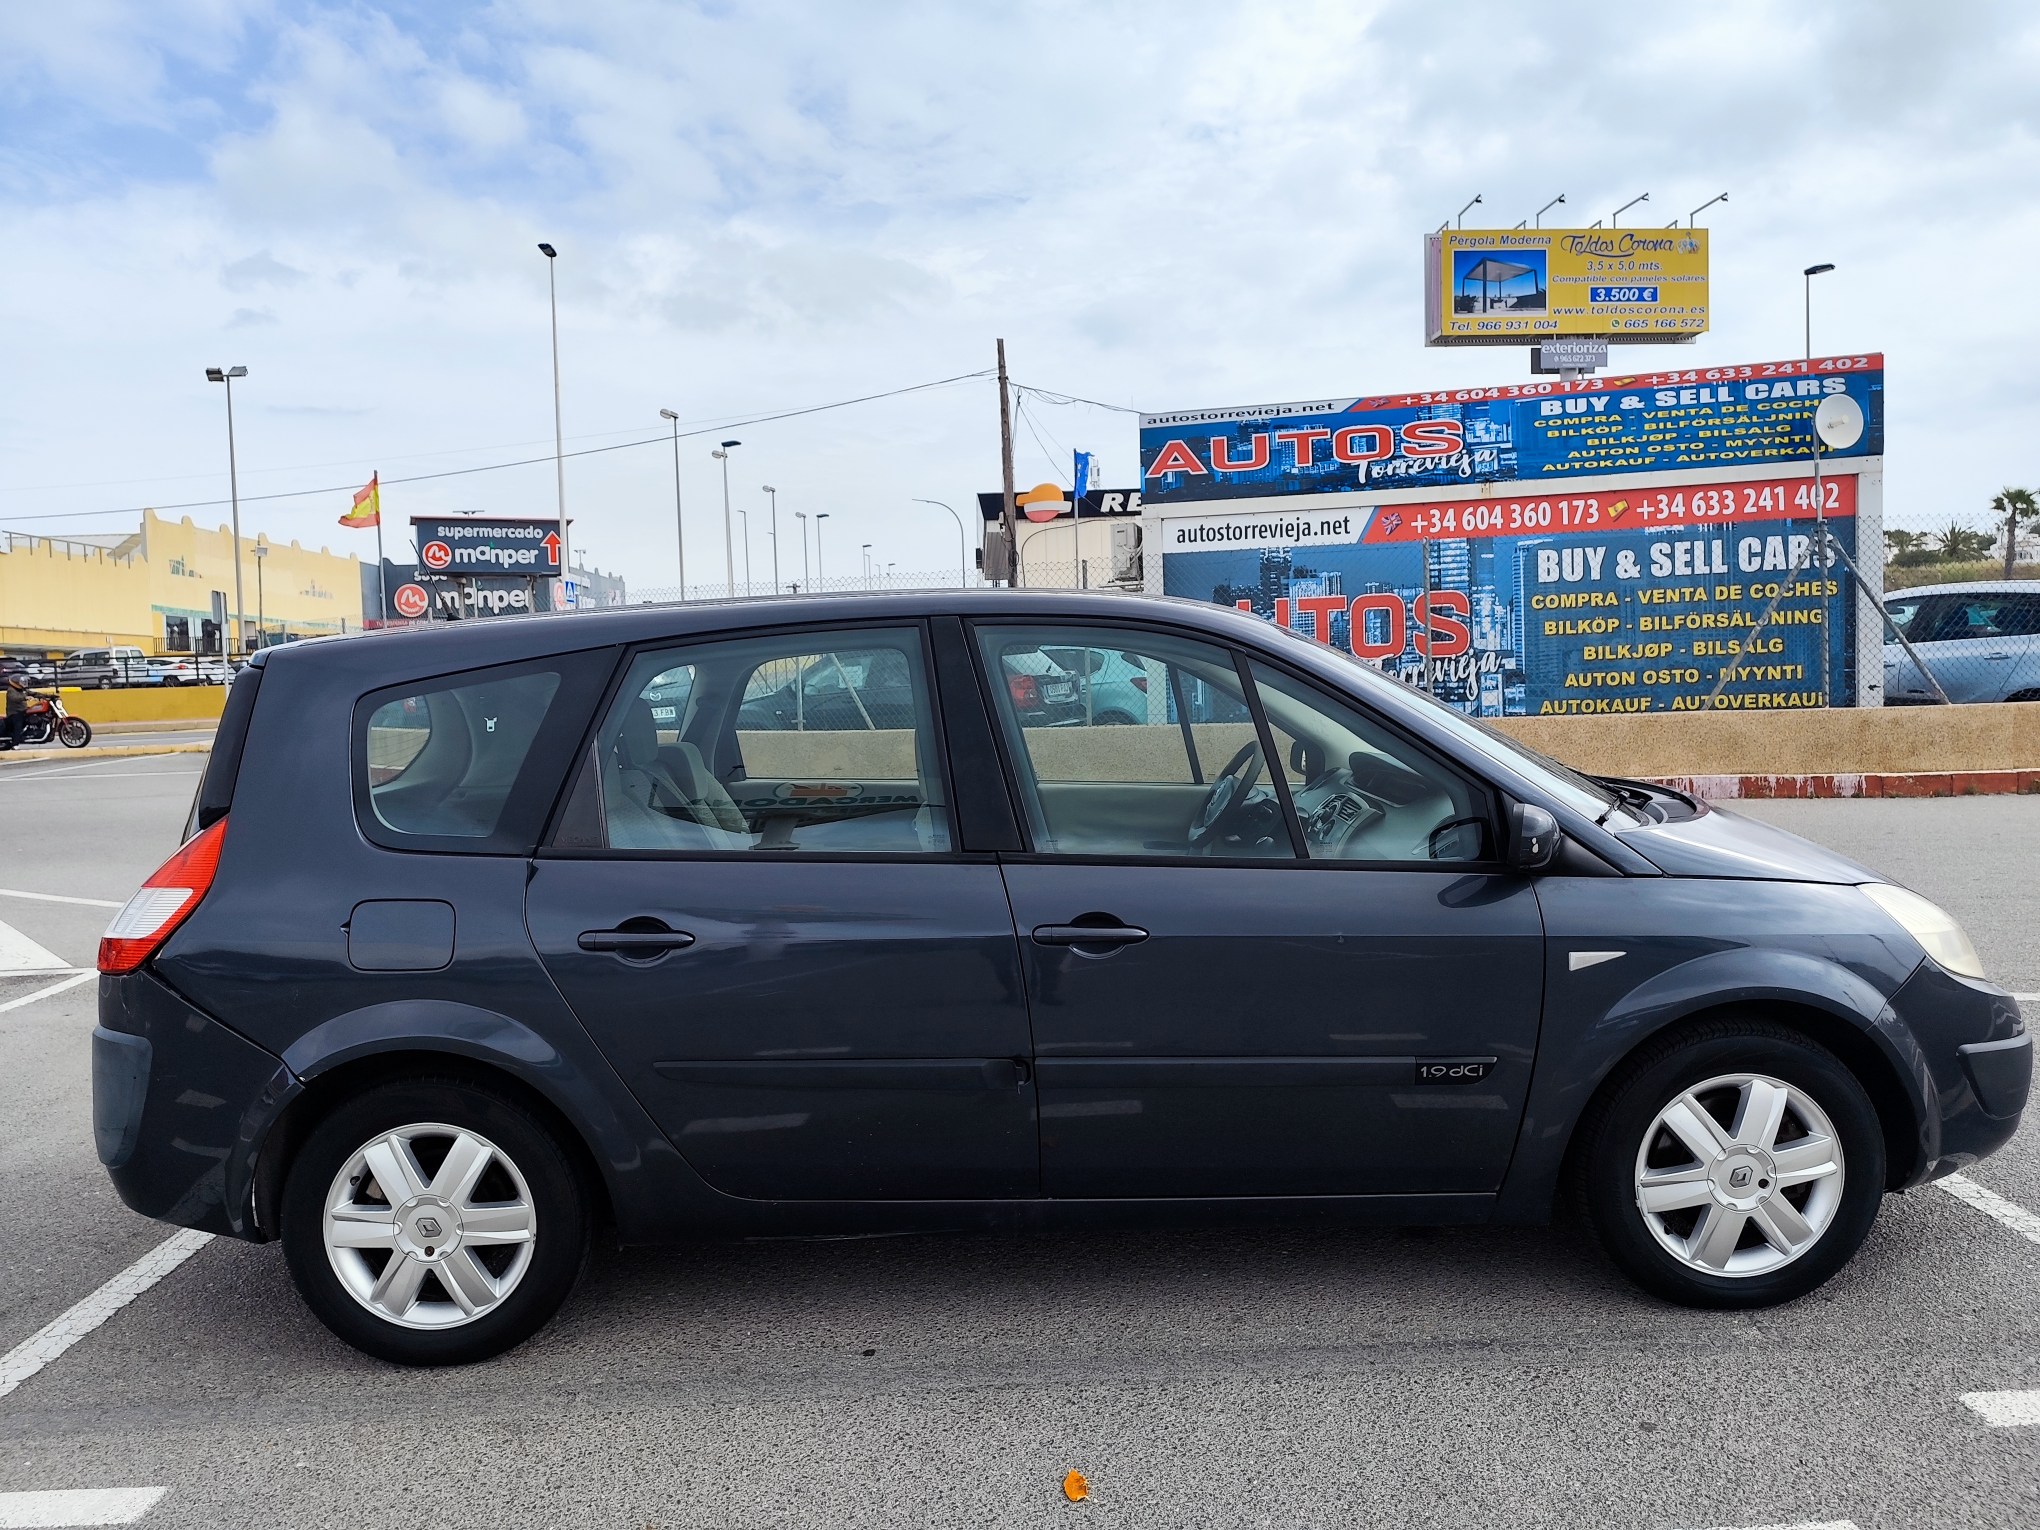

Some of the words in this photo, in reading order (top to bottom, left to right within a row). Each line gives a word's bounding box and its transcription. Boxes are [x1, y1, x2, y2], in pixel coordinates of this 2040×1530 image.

[1499, 235, 1552, 245] Moderna
[1560, 234, 1615, 257] Toldos
[1618, 233, 1675, 253] Corona
[1586, 260, 1604, 271] 3,5
[1607, 263, 1614, 271] x
[1617, 260, 1635, 271] 5,0
[1638, 261, 1663, 271] mts.
[1552, 275, 1607, 284] Compatible
[1630, 275, 1668, 284] paneles
[1671, 274, 1706, 283] solares
[1595, 288, 1639, 301] 3.500
[1642, 288, 1654, 301] €
[1552, 305, 1705, 315] www.toldoscorona.es
[1449, 321, 1472, 331] Tel.
[1477, 321, 1502, 331] 966
[1505, 320, 1529, 330] 931
[1533, 320, 1558, 330] 004
[1624, 318, 1649, 329] 665
[1653, 318, 1677, 328] 166
[1680, 318, 1705, 328] 572
[1645, 370, 1698, 384] +34
[1705, 366, 1753, 380] 633
[1761, 361, 1808, 376] 241
[1818, 357, 1868, 371] 402
[1400, 390, 1449, 405] +34
[1455, 387, 1500, 401] 604
[1507, 383, 1552, 397] 360
[1560, 378, 1605, 392] 173
[1540, 395, 1611, 417] BUY
[1619, 395, 1646, 410] &
[1654, 386, 1735, 408] SELL
[1745, 377, 1847, 401] CARS
[1147, 402, 1336, 426] autostorrevieja.net
[1533, 414, 1622, 428] COMPRA
[1642, 407, 1714, 420] VENTA
[1721, 404, 1750, 414] DE
[1757, 398, 1821, 411] COCH
[1547, 425, 1624, 438] BILKÖP
[1644, 411, 1815, 431] BILFÖRSÄLJNIN
[1567, 446, 1640, 459] AUTON
[1647, 442, 1705, 453] OSTO
[1725, 434, 1812, 448] MYYNTI
[1586, 432, 1678, 446] BILKJØP
[1698, 424, 1792, 439] BILSALG
[1145, 419, 1464, 480] AUTOS
[1351, 449, 1497, 484] Torrevieja
[1541, 456, 1656, 472] AUTOKAUF
[1636, 492, 1686, 520] +34
[1692, 489, 1736, 516] 633
[1743, 485, 1786, 514] 241
[1794, 482, 1840, 510] 402
[1410, 507, 1457, 535] +34
[1460, 505, 1504, 531] 604
[1509, 502, 1552, 528] 360
[1558, 498, 1600, 525] 173
[437, 525, 544, 540] supermercado
[1176, 515, 1351, 544] autostorrevieja.net
[454, 546, 539, 569] manper
[1537, 546, 1607, 583] BUY
[1615, 549, 1641, 580] &
[1650, 539, 1728, 578] SELL
[1738, 533, 1836, 574] CARS
[1531, 592, 1619, 610] COMPRA
[1637, 587, 1708, 605] VENTA
[1715, 584, 1743, 601] DE
[1544, 616, 1620, 636] BILKÖP
[1583, 642, 1673, 661] BILKJØP
[1564, 671, 1636, 688] AUTON
[1642, 668, 1700, 685] OSTO
[1539, 697, 1652, 715] AUTOKAUF
[1420, 1065, 1447, 1078] 1.9
[1449, 1064, 1484, 1077] dCi
